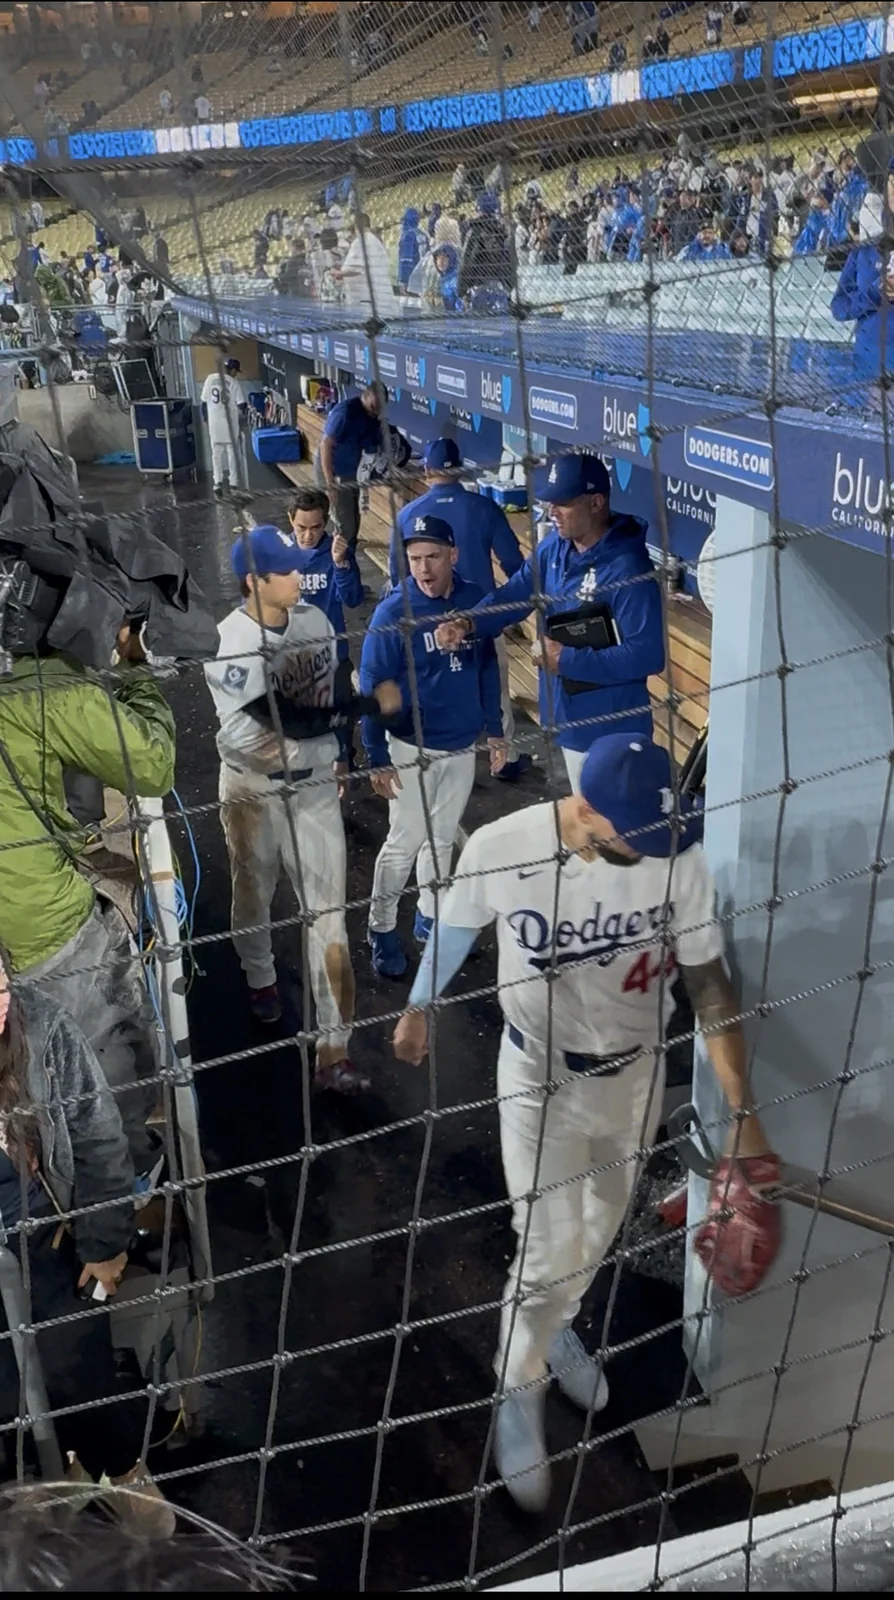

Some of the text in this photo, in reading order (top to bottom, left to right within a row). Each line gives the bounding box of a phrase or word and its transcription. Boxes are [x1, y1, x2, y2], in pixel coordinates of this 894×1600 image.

[481, 371, 502, 403] blue
[603, 396, 637, 436] blue
[689, 437, 770, 477] DODGERS.COM
[414, 517, 427, 531] LA
[666, 498, 715, 526] CALIFORNI
[298, 573, 328, 590] GERS
[450, 653, 462, 672] LA
